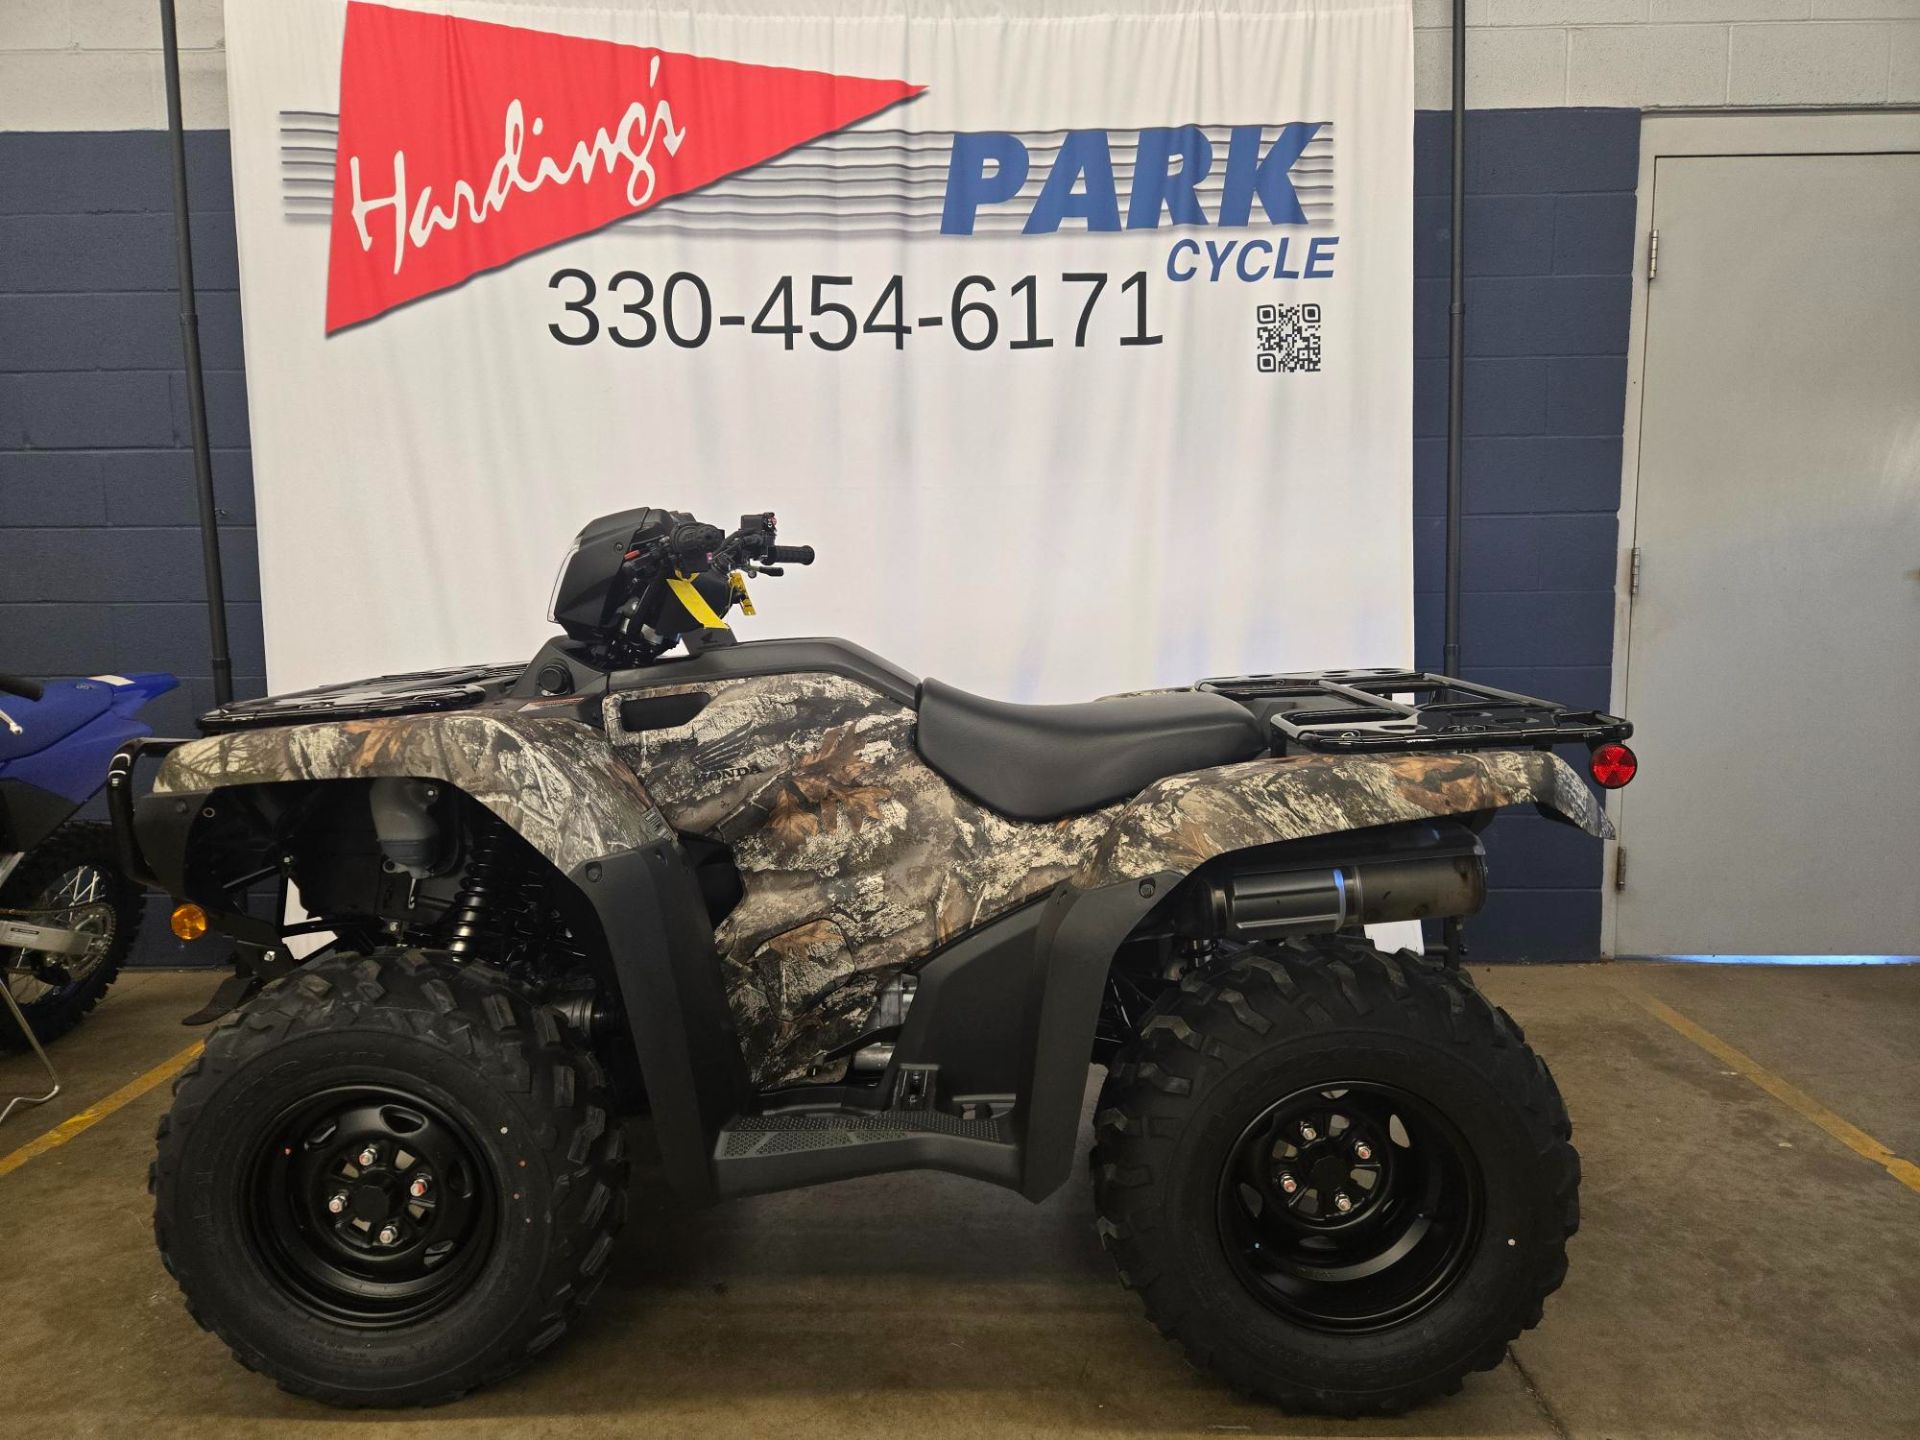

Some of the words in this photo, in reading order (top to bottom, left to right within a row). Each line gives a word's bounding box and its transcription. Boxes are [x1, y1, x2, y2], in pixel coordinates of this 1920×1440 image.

[940, 123, 1321, 235] PARK
[1166, 236, 1340, 282] CYCLE
[547, 268, 1164, 351] 330-454-6171
